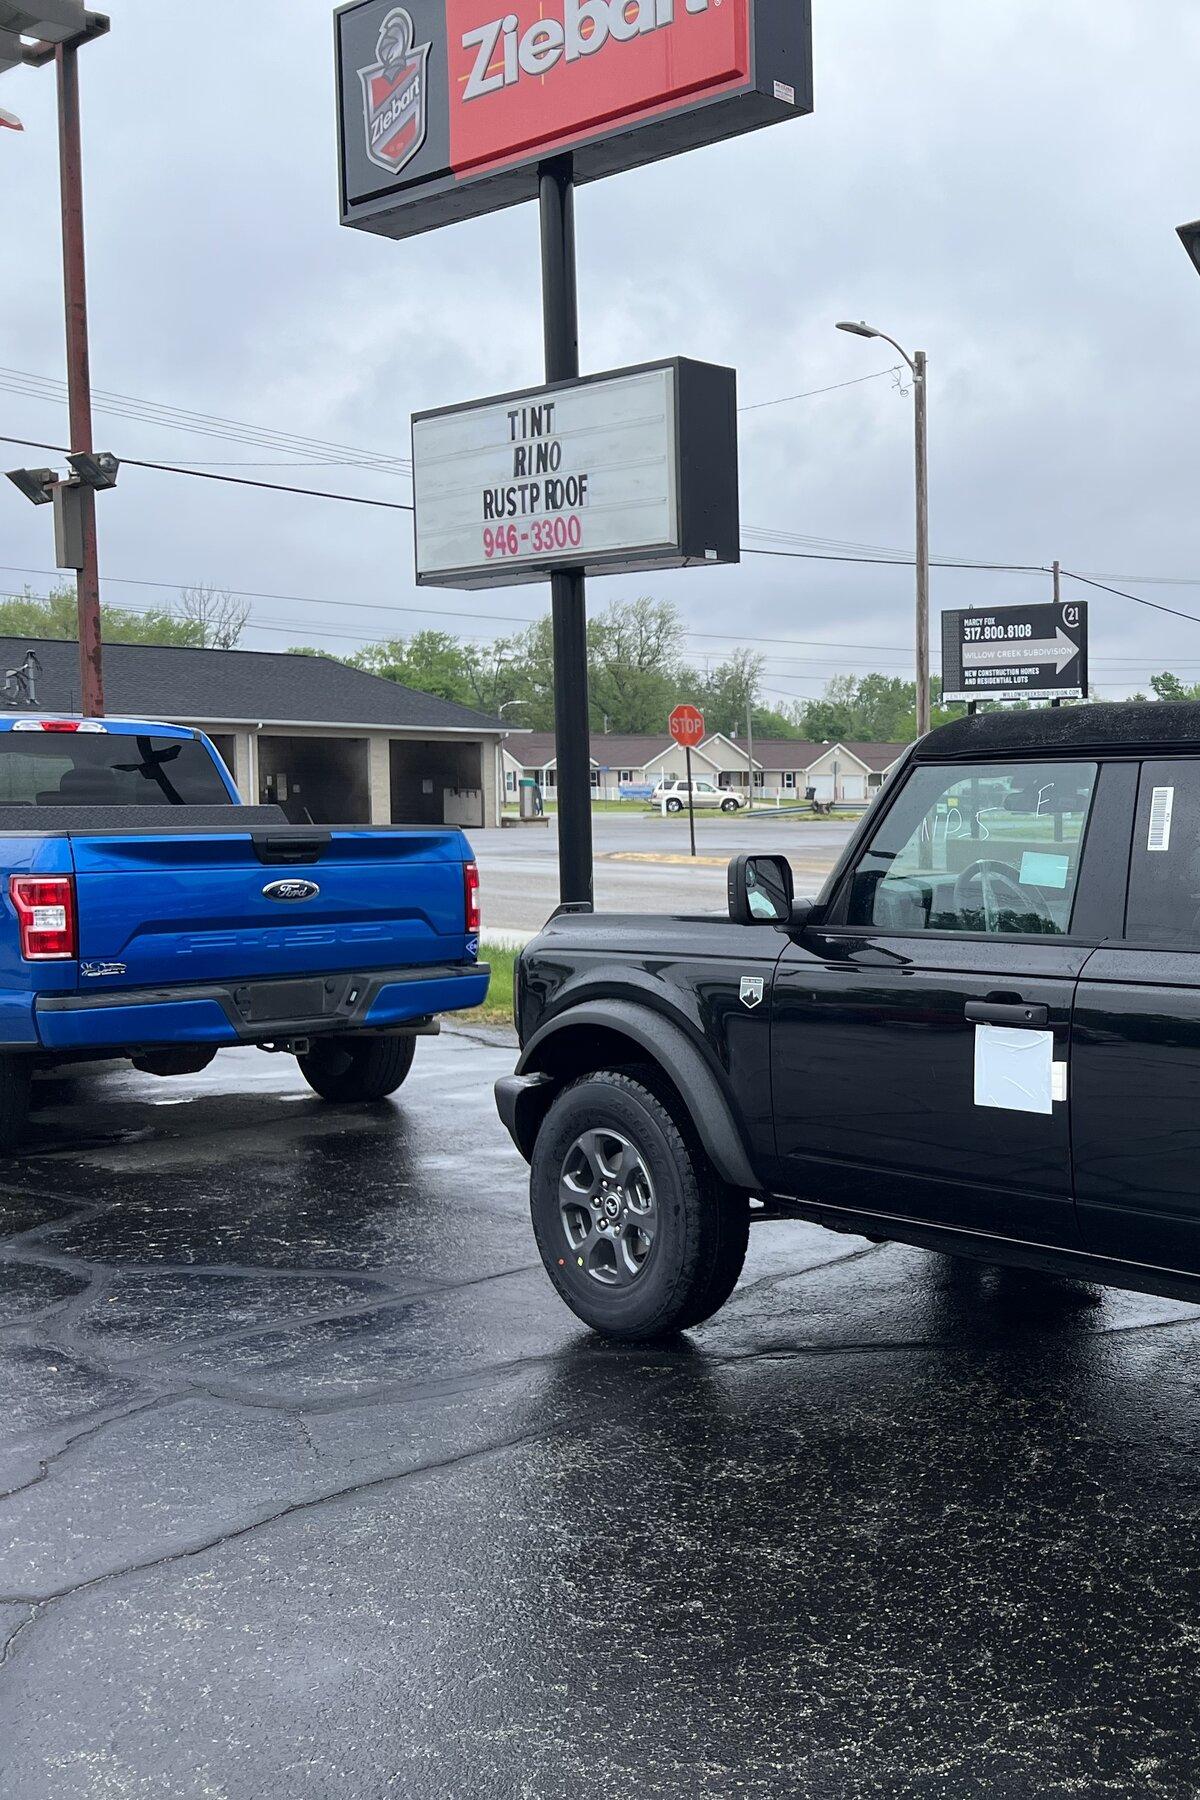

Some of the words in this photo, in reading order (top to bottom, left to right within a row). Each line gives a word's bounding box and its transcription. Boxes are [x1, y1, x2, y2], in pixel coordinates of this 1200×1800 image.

[461, 0, 709, 101] Zieba
[371, 75, 420, 145] Ziebart
[507, 402, 555, 441] TINT
[513, 440, 562, 478] RINO
[483, 474, 588, 520] RUSTPROOF
[483, 514, 581, 558] 946-3300
[964, 618, 983, 627] MARCY
[984, 617, 996, 626] FOX
[964, 624, 1032, 641] 317.800.8108
[964, 651, 995, 660] WILLOW
[997, 649, 1022, 658] CREEK
[1023, 646, 1073, 657] SUBDIVISION
[964, 670, 977, 678] NEW
[977, 668, 1020, 677] CONSTRUCTION
[1020, 667, 1040, 675] HOMES
[964, 677, 976, 685] AND
[977, 676, 1013, 685] RESIDENTIAL
[1013, 675, 1029, 684] LOTS
[672, 718, 702, 734] STOP
[278, 884, 308, 897] Ford
